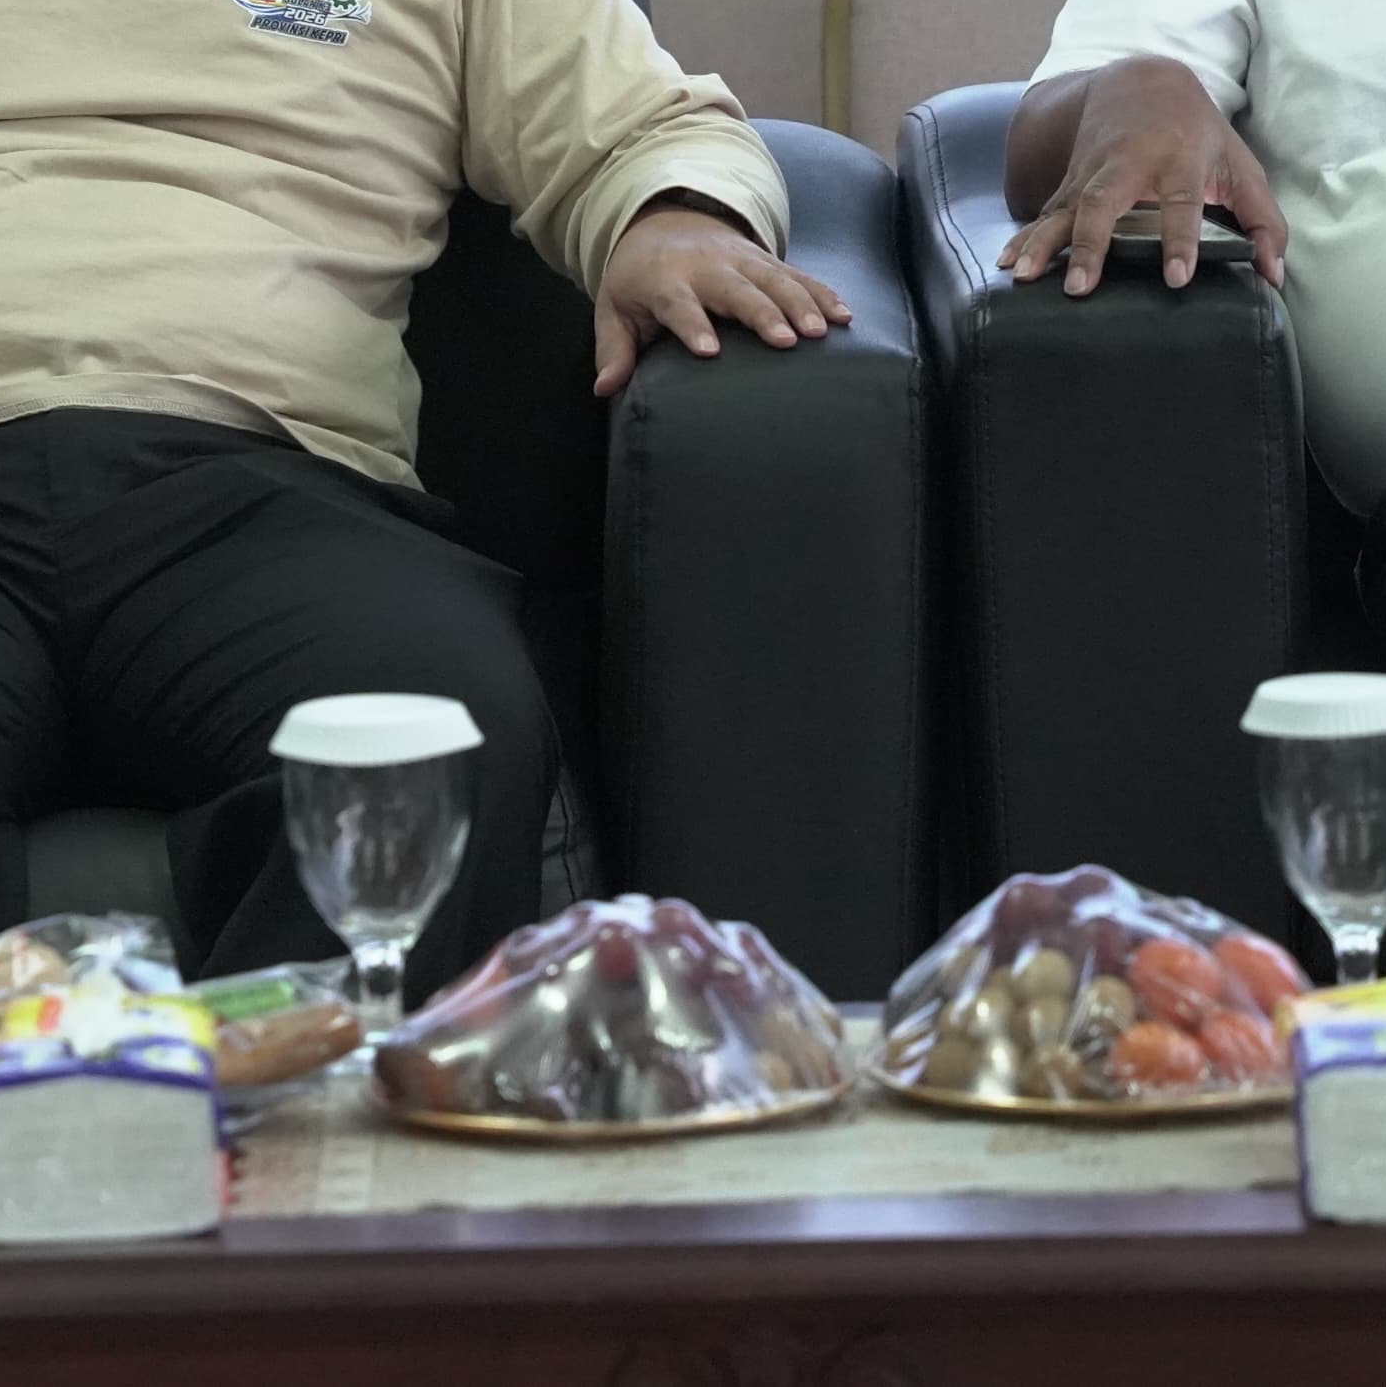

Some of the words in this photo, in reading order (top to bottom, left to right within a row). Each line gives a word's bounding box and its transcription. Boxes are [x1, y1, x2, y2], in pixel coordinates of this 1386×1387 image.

[283, 7, 326, 25] 2026
[251, 16, 310, 36] PROVINSI
[310, 26, 348, 44] KEPRI
